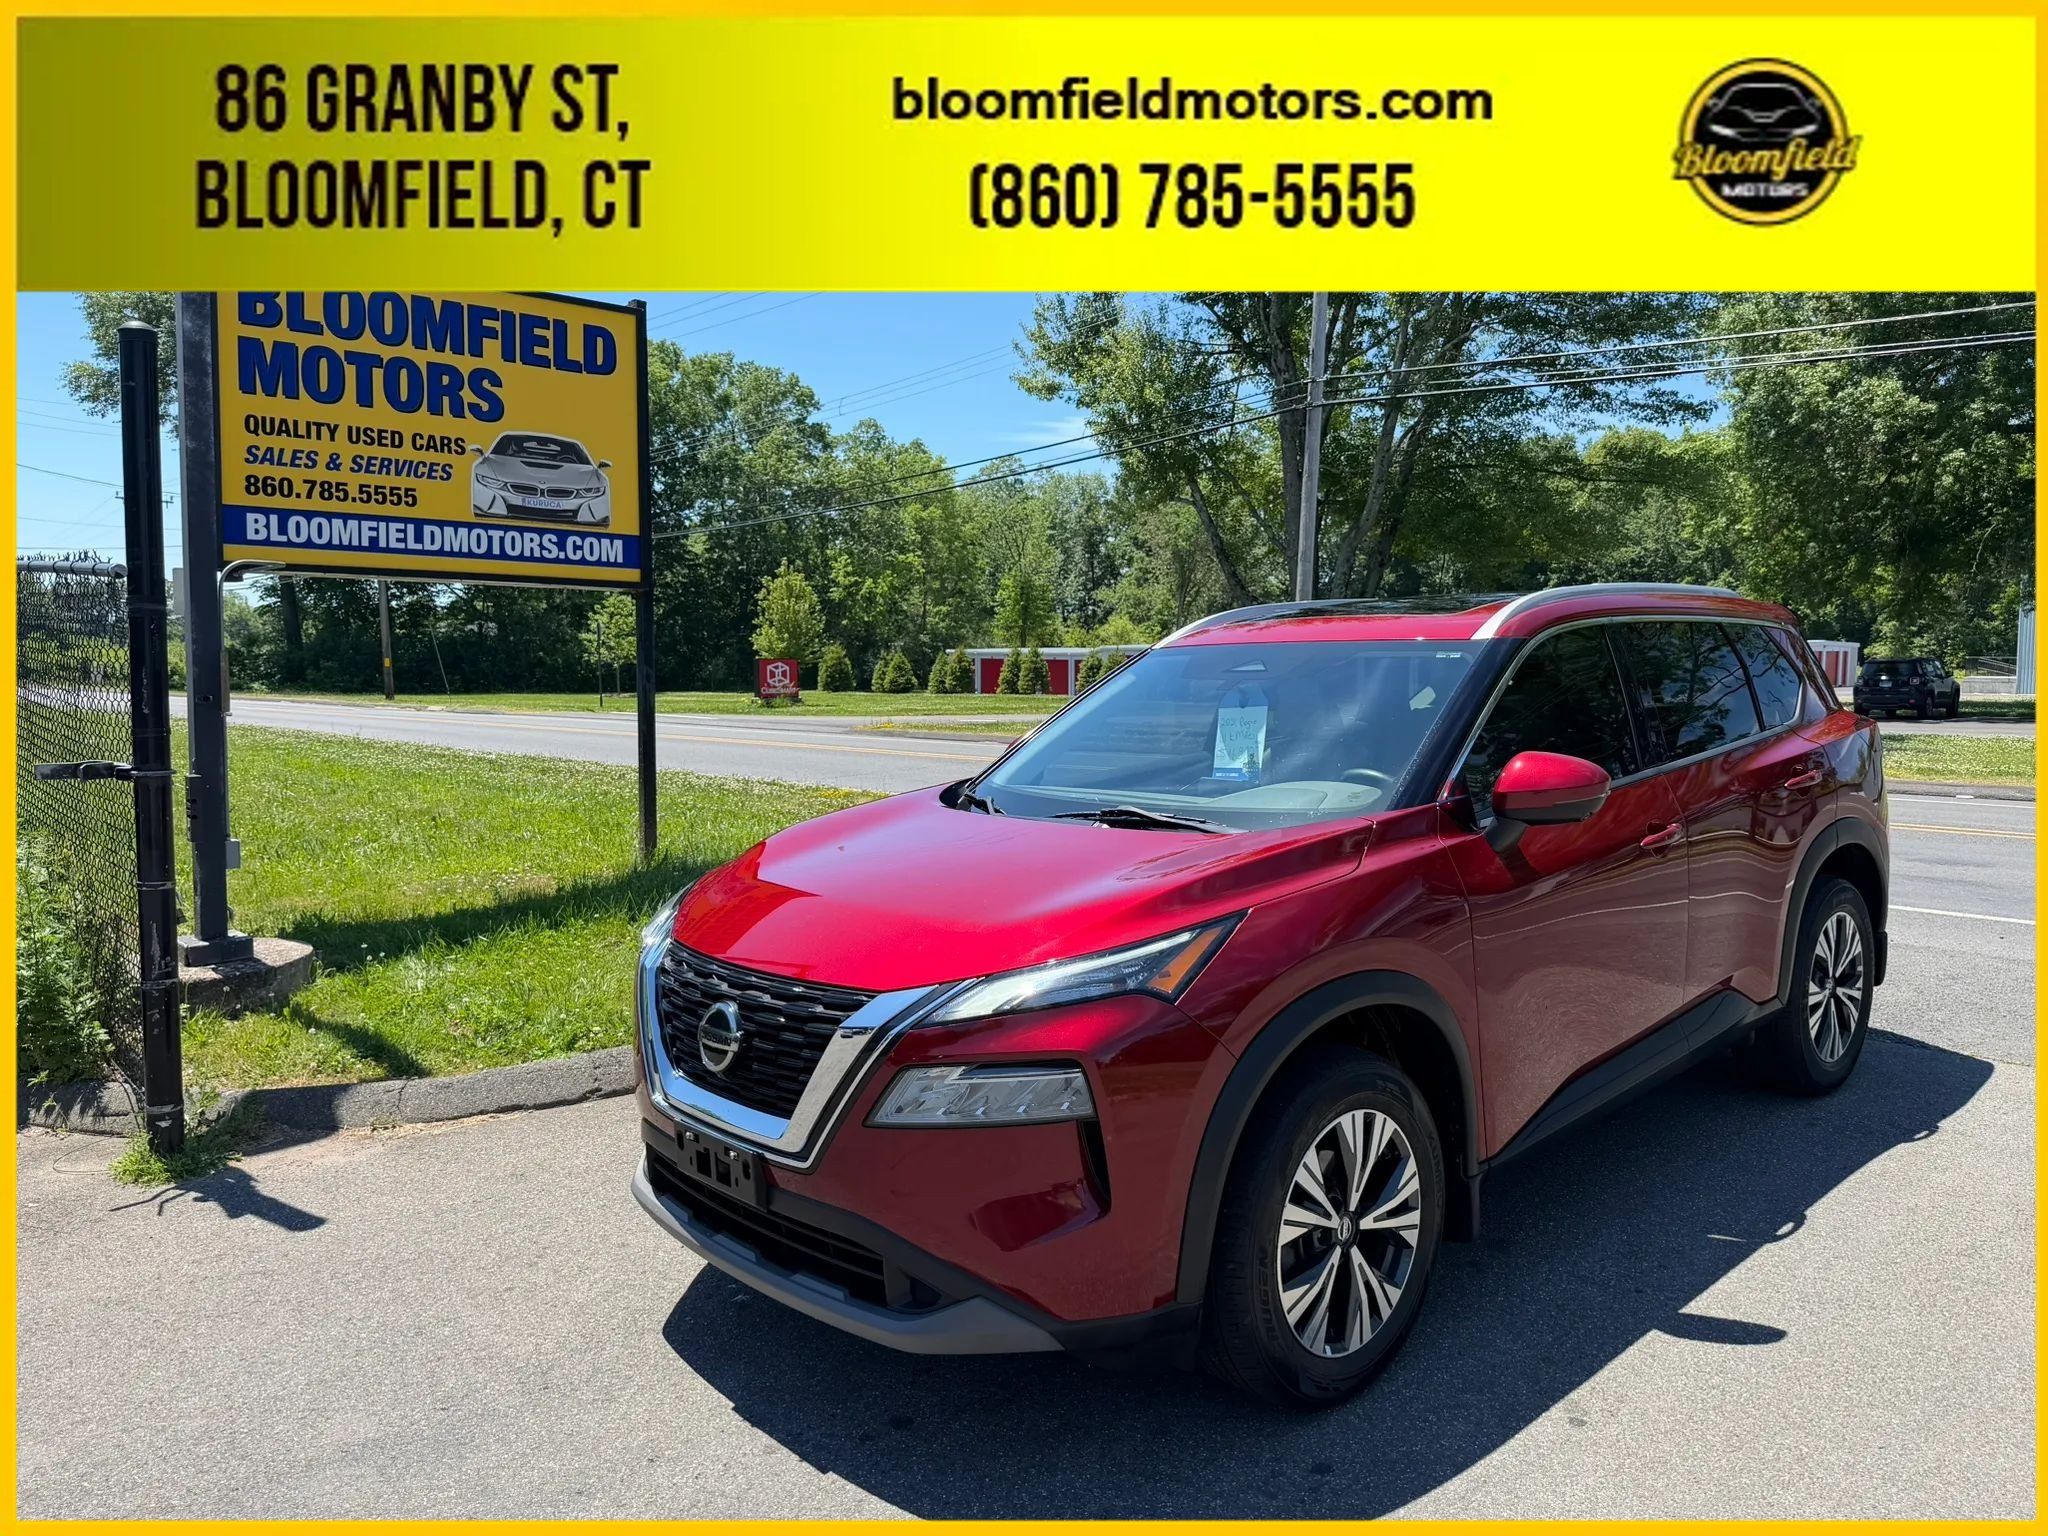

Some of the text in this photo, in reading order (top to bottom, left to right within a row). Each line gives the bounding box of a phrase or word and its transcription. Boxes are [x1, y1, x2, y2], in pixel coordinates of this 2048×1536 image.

[237, 291, 617, 376] BLOOMFIELD
[237, 335, 505, 422] MOTORS
[244, 414, 467, 456] QUALITY USED CARS
[244, 444, 454, 482] SALES & SERVICES
[244, 474, 418, 508] 860.785.5555
[246, 512, 624, 563] BLOOMFIELDMOTORS.COM
